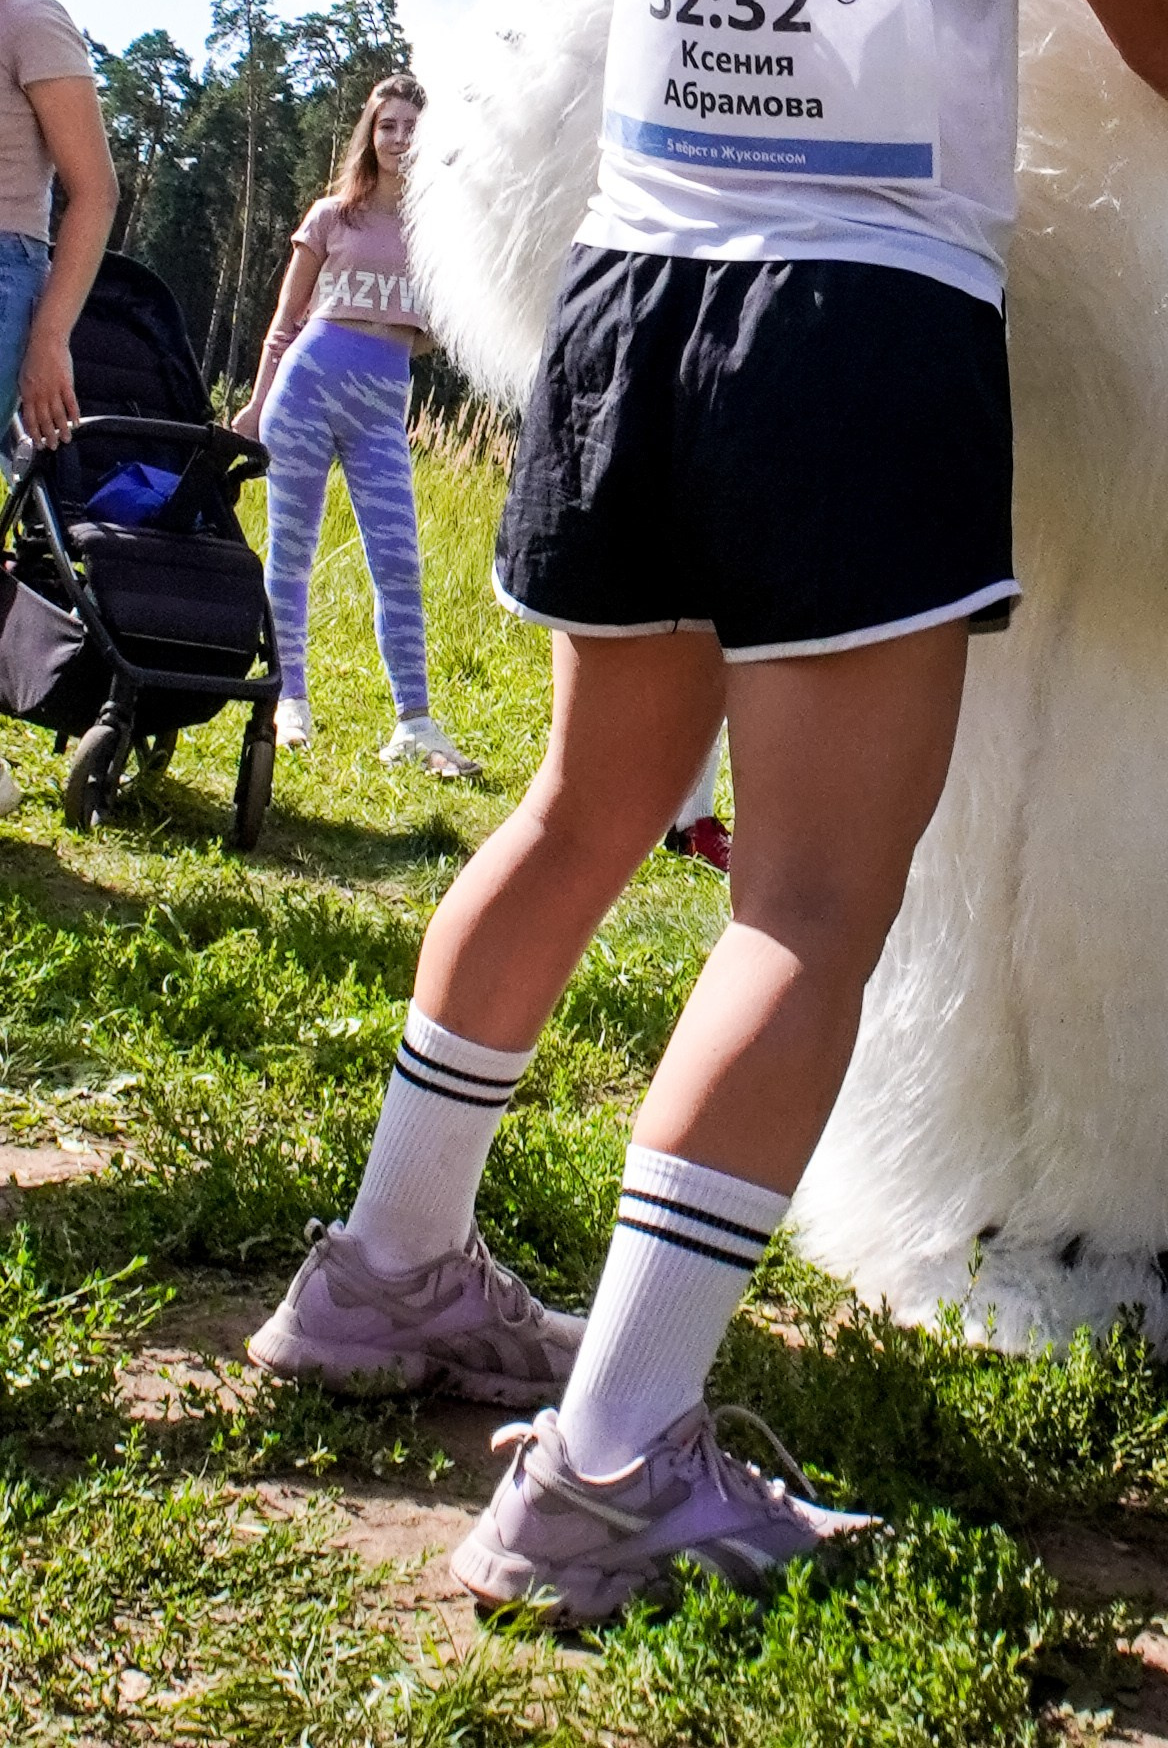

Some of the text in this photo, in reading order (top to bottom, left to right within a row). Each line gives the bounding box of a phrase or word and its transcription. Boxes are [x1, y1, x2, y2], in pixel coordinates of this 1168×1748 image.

[681, 39, 794, 77] Ксения
[664, 78, 824, 119] Абрамова
[667, 138, 674, 152] 5
[721, 146, 806, 164] Жуковском
